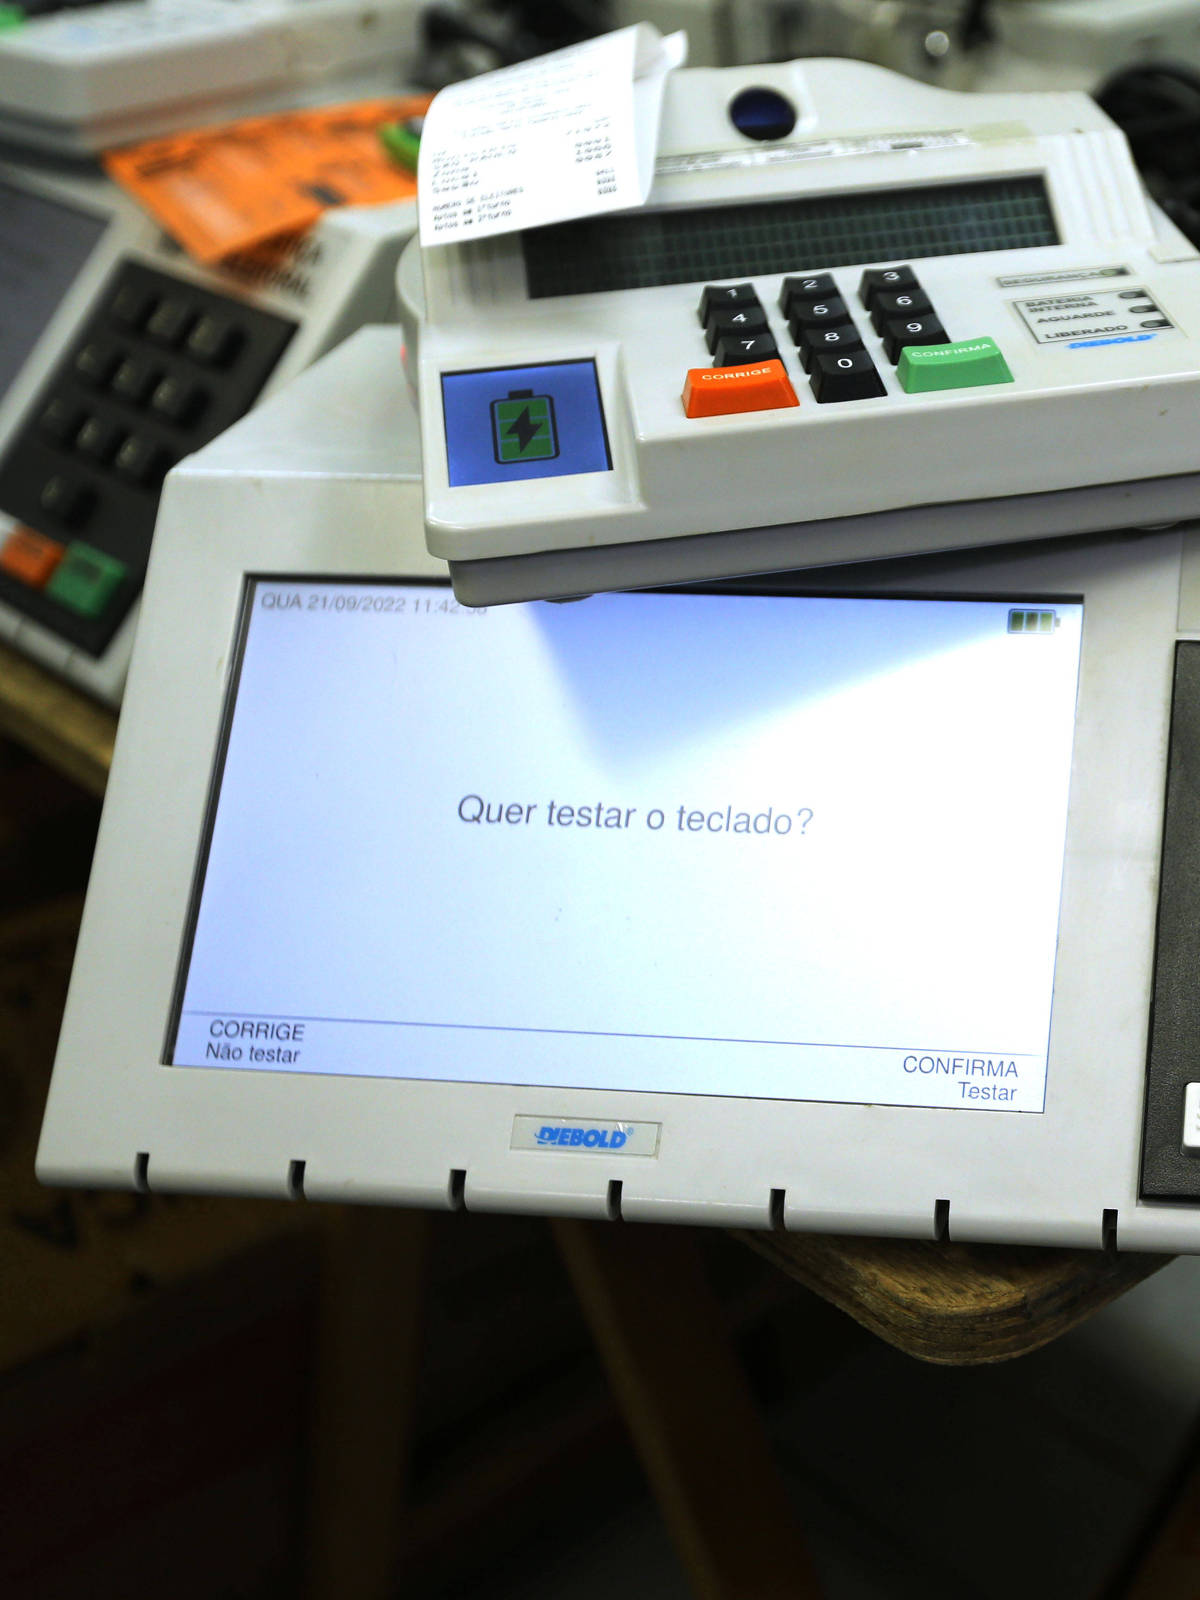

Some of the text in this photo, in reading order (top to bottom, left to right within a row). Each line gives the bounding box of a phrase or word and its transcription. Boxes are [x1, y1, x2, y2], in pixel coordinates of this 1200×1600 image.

[883, 271, 900, 281] 3
[803, 279, 818, 289] 2
[727, 288, 737, 298] 1
[896, 296, 912, 305] 6
[1025, 296, 1093, 307] BATERIA
[813, 304, 829, 314] 5
[1028, 302, 1098, 312] INTERNA
[732, 313, 747, 323] 4
[1037, 311, 1116, 323] AGUARDE
[906, 322, 922, 332] 9
[1045, 325, 1128, 339] LIBERADO
[824, 331, 840, 341] 8
[741, 340, 756, 350] 7
[911, 342, 992, 359] CONFIRMA
[837, 358, 853, 369] 0
[702, 366, 772, 380] CORRIGE
[261, 592, 301, 611] QUA
[307, 594, 406, 613] 21/09/2022
[457, 794, 815, 836] Quer testar o teclado?
[210, 1019, 305, 1042] CORRIGE
[206, 1041, 301, 1064] Não testar
[903, 1055, 1019, 1078] CONFIRMA
[957, 1081, 1018, 1101] Testar
[535, 1126, 627, 1149] DIEBOLD
